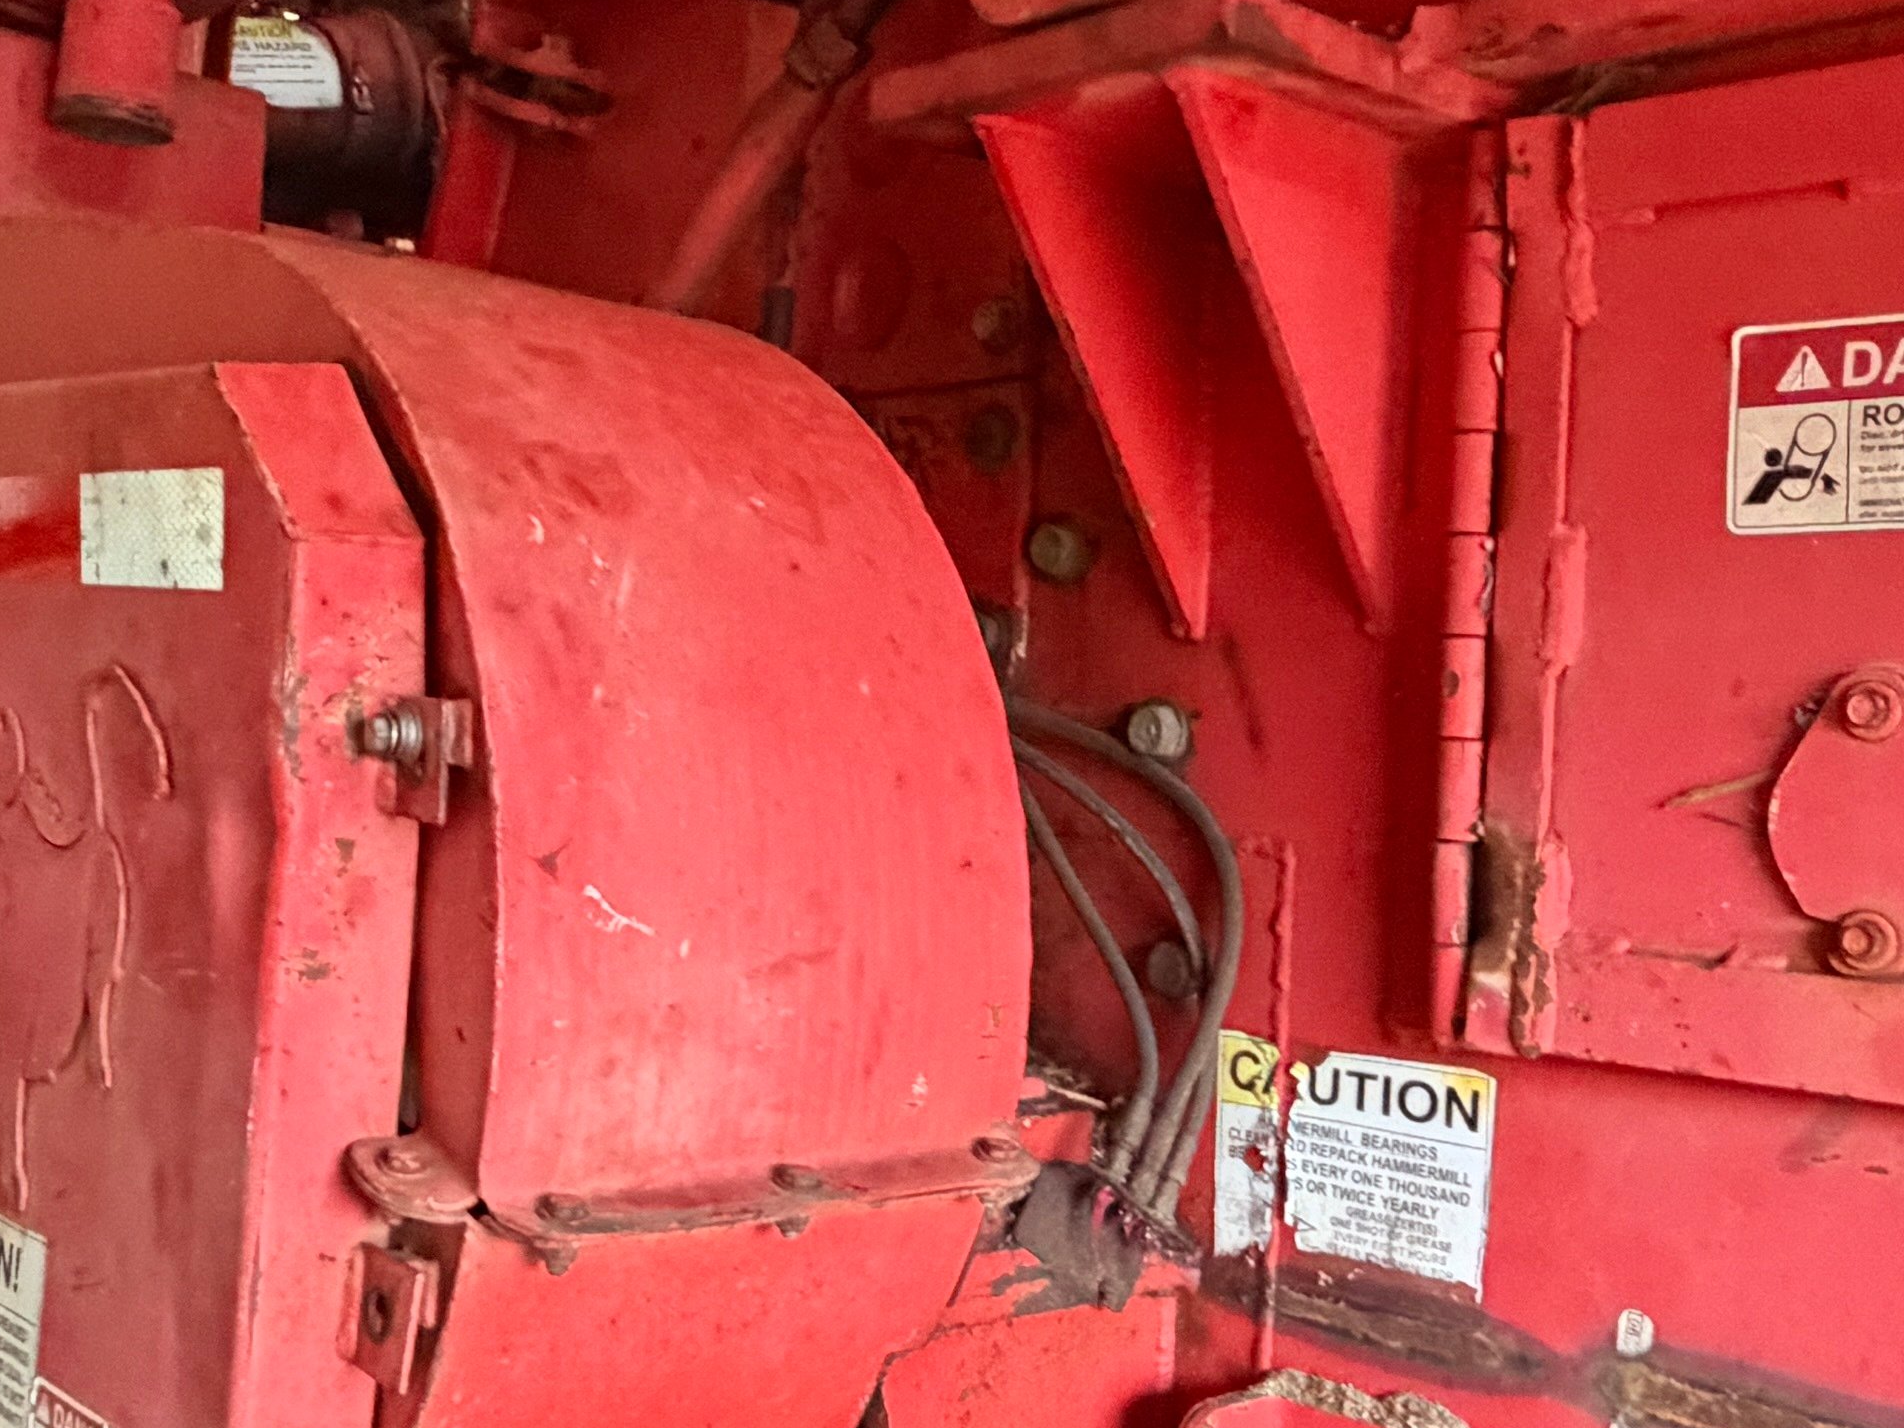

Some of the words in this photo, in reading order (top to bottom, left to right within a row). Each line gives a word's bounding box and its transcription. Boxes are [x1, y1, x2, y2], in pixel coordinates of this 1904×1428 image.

[1860, 444, 1876, 453] for
[1361, 1132, 1438, 1161] BEARINGS
[1310, 1142, 1368, 1166] REPACK
[1371, 1154, 1472, 1188] HAMMERMILL
[1301, 1159, 1347, 1181] EVERY
[1351, 1169, 1383, 1189] ONE
[1387, 1177, 1471, 1208] THOUSAND
[1306, 1178, 1327, 1197] OR
[1331, 1183, 1376, 1207] TWICE
[1380, 1194, 1440, 1220] YEARLY
[1405, 1234, 1453, 1253] GREASE
